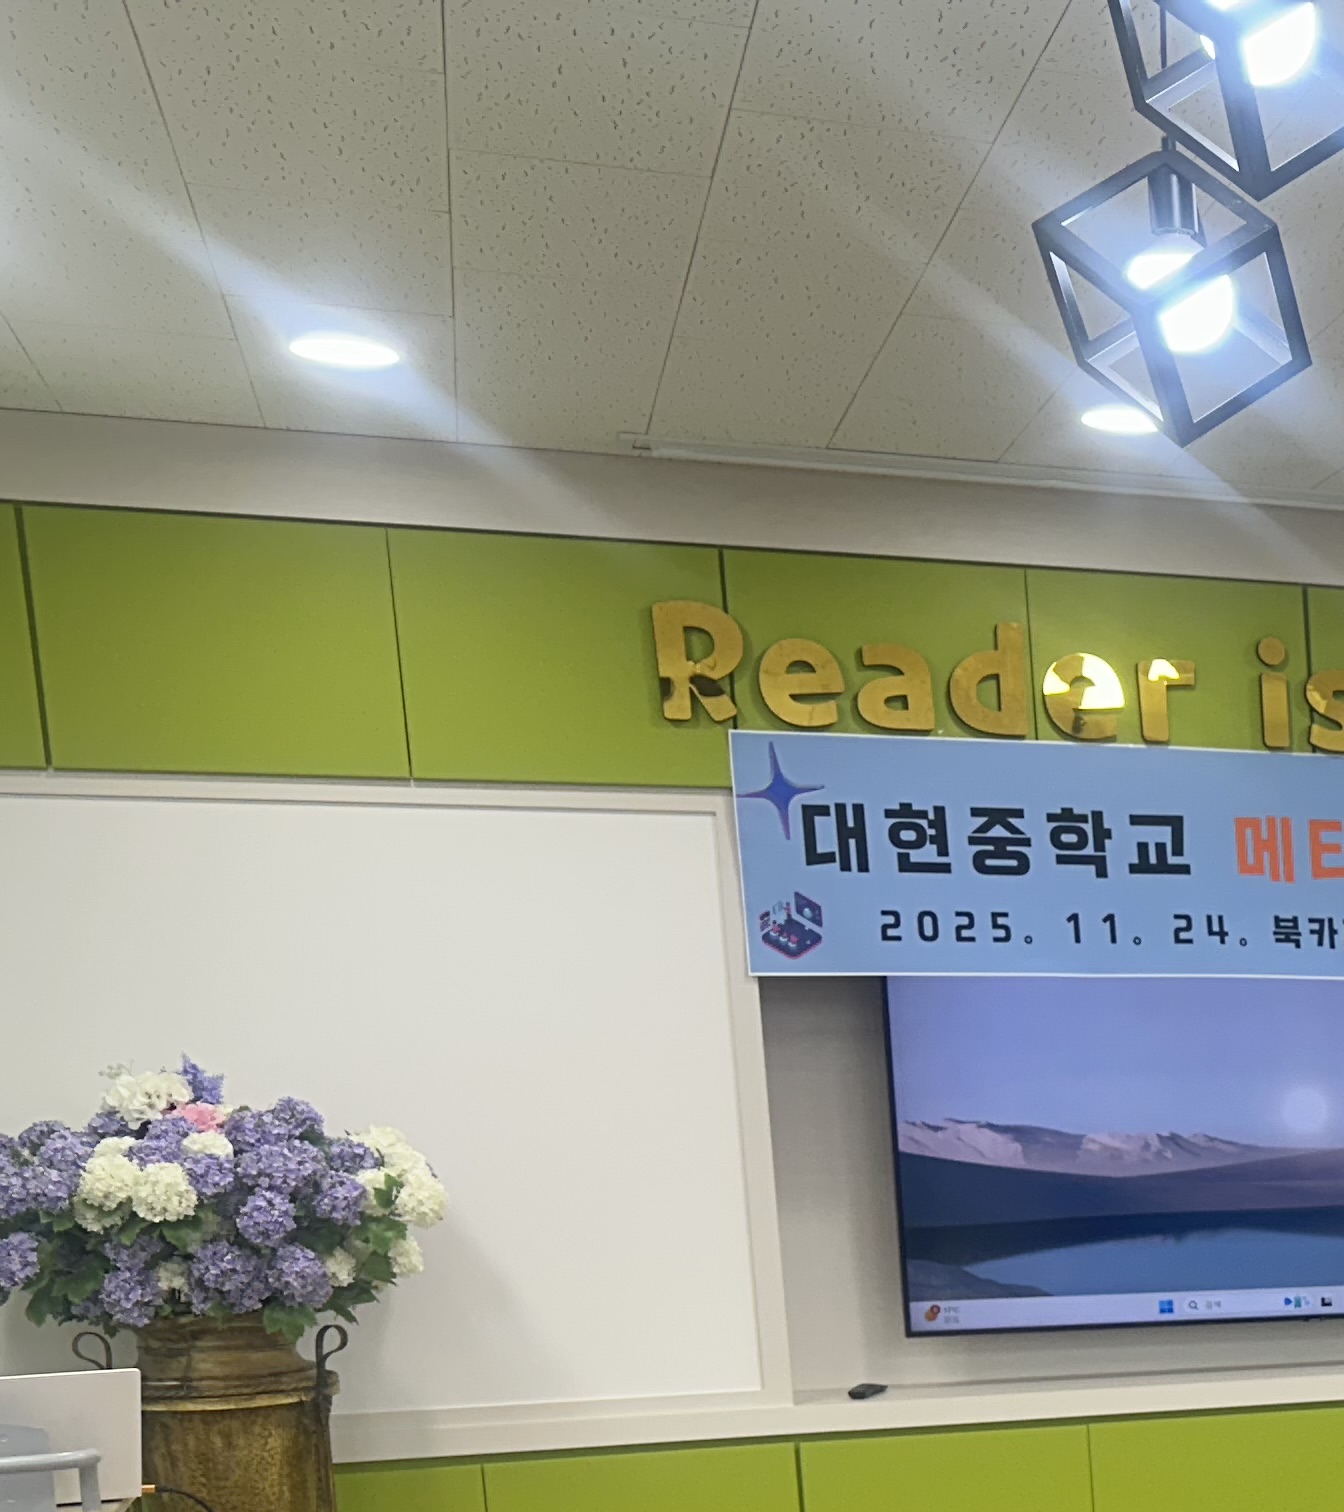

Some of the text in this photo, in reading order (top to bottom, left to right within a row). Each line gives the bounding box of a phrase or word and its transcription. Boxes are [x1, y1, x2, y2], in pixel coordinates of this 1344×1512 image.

[651, 600, 1196, 743] Reader
[801, 802, 1192, 879] 대현중학교
[880, 909, 1034, 946] 2025.
[1066, 912, 1142, 947] 11.
[1173, 914, 1248, 948] 24.
